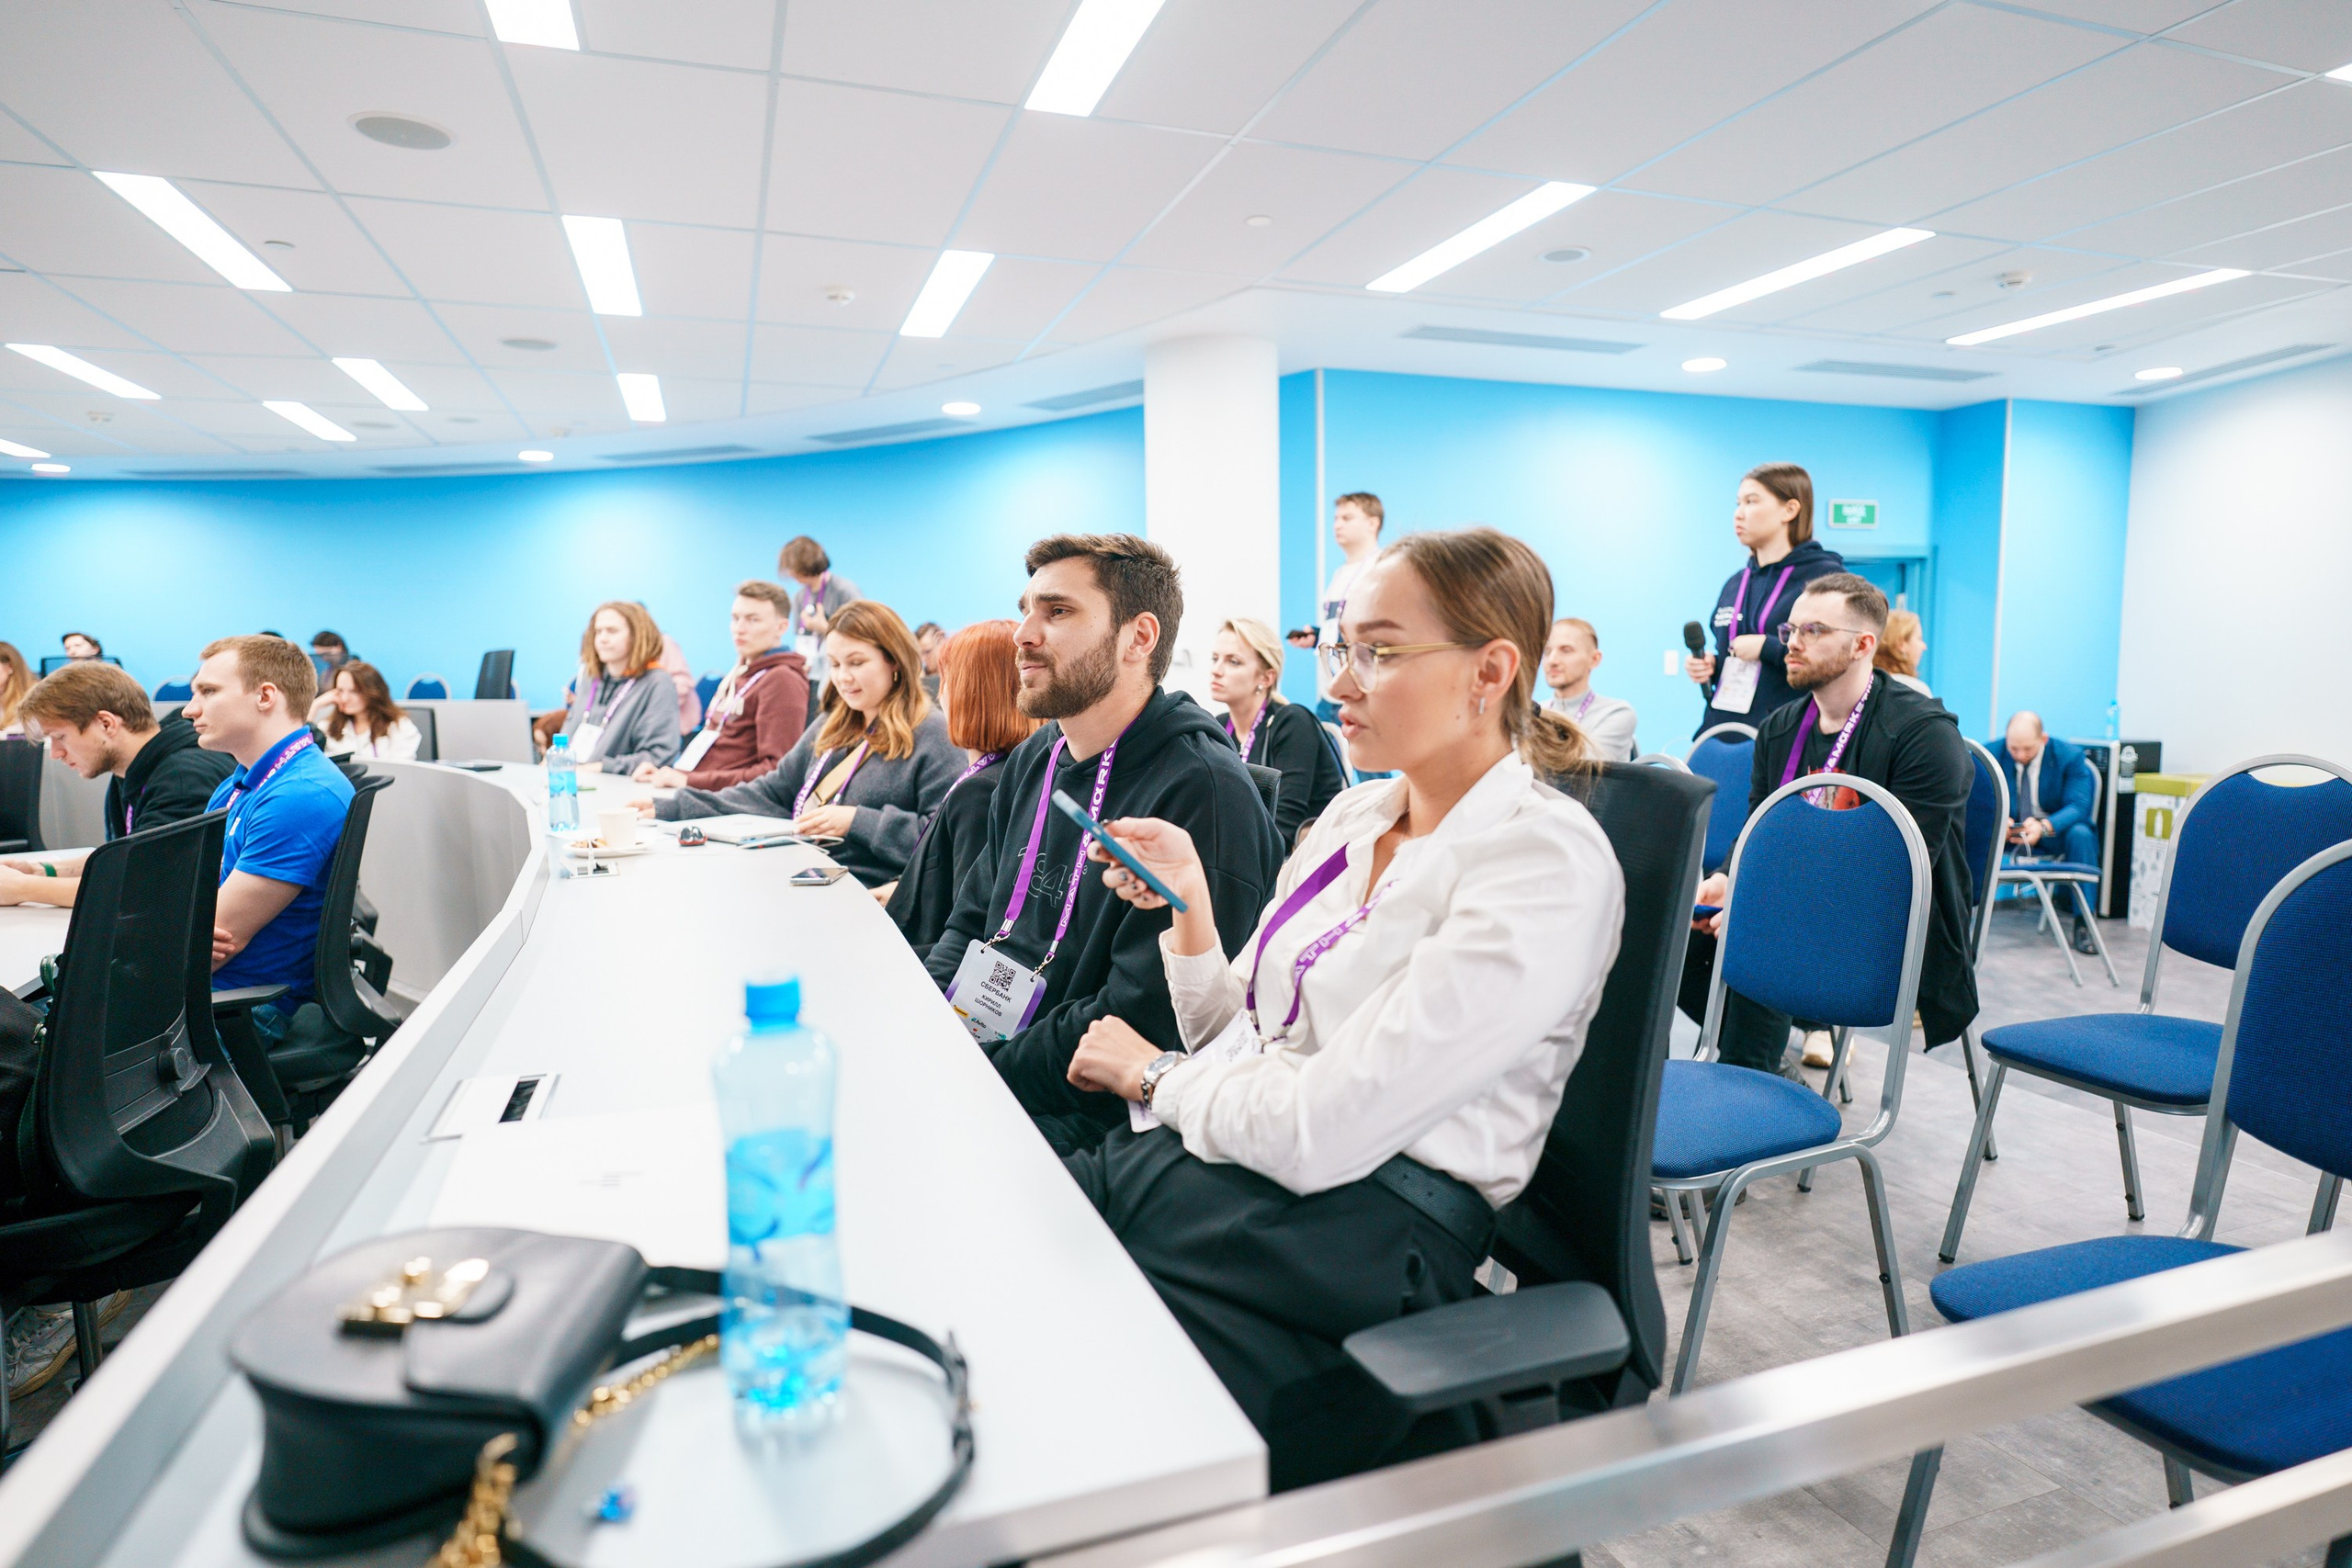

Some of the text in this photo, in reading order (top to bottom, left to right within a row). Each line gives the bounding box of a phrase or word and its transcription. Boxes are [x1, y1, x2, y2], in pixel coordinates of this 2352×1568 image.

[1060, 850, 1087, 926] MATH
[980, 981, 1012, 1002] СБЕРБАНК
[981, 994, 1001, 1009] КИРИЛЛ
[974, 998, 1002, 1017] ШОРНИКОВ
